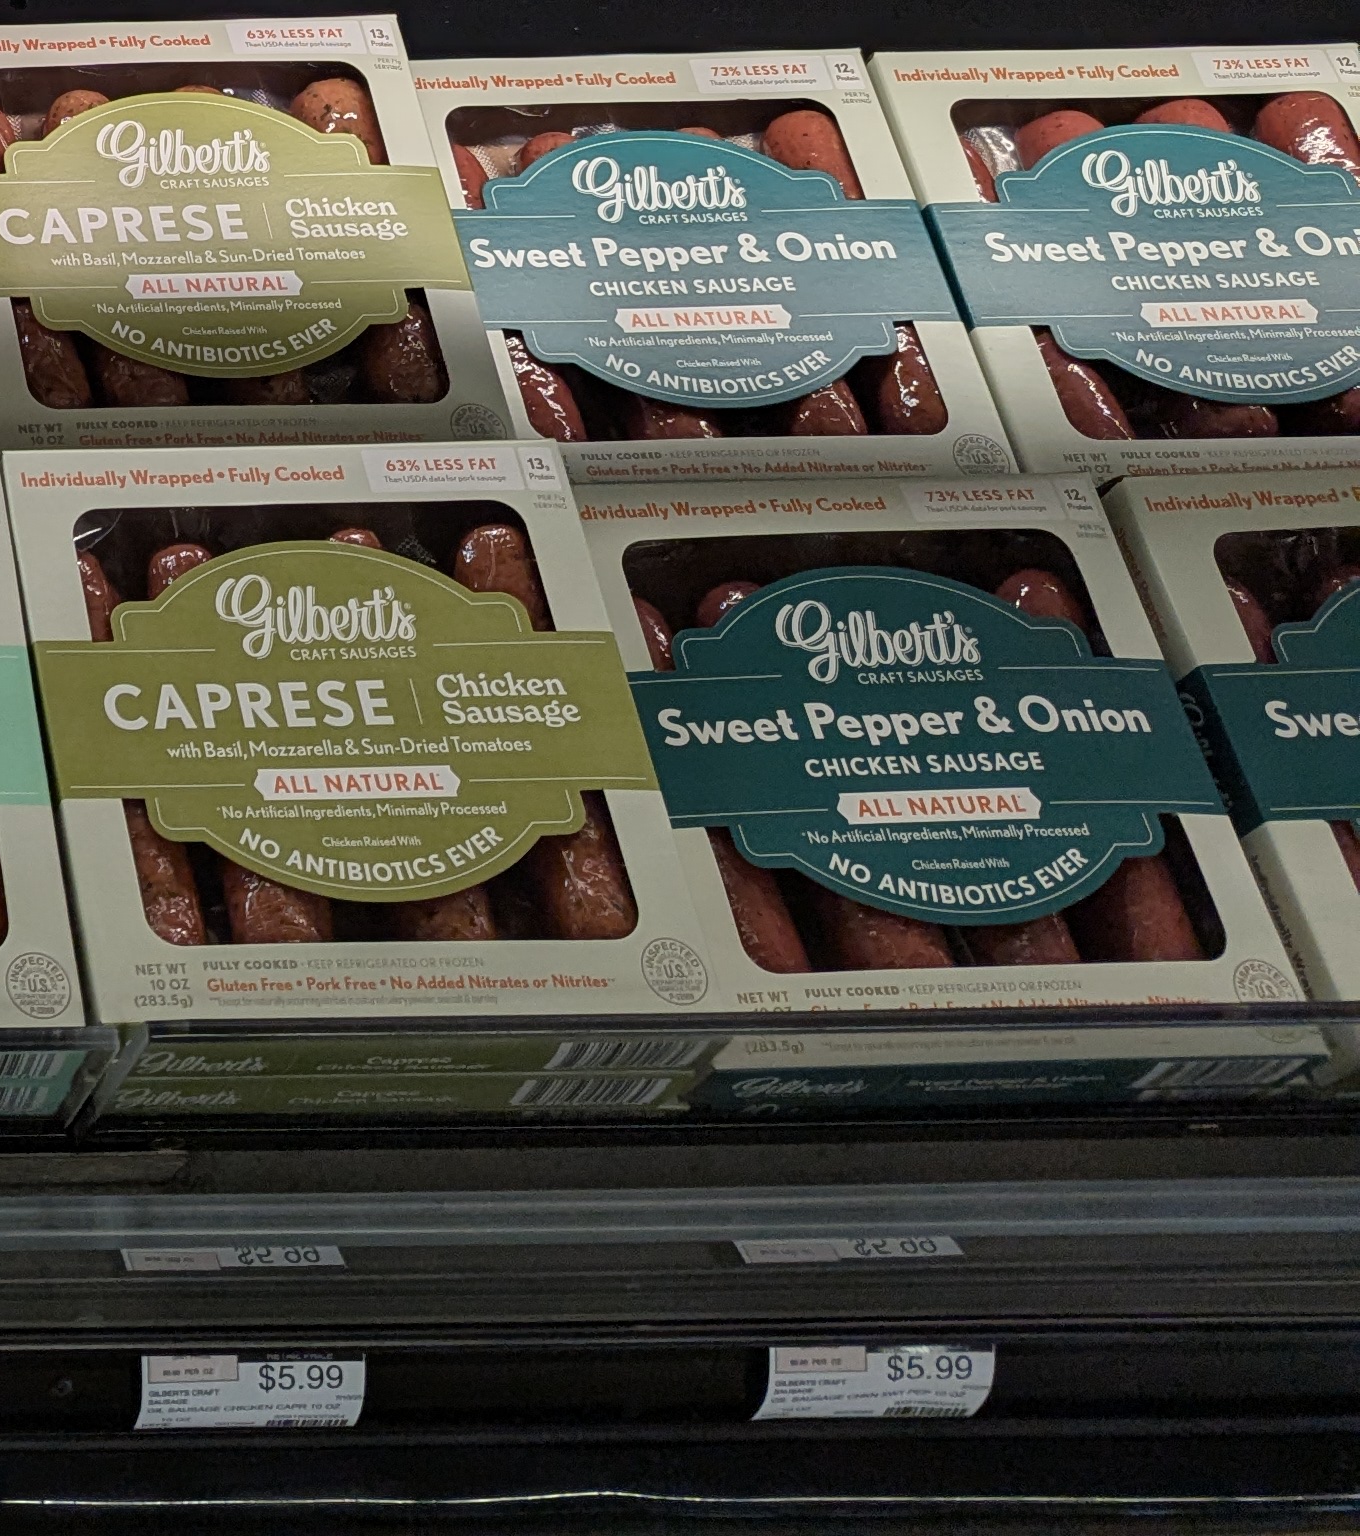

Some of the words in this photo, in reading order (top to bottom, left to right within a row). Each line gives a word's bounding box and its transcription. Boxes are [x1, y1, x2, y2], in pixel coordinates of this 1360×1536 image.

[96, 121, 270, 188] Gilbert's
[572, 157, 747, 223] Gilbert's
[1082, 150, 1262, 217] Gilbert's
[285, 197, 397, 217] Chicken
[290, 219, 409, 240] Sausage
[51, 255, 80, 267] with
[83, 252, 120, 268] Basil,
[123, 251, 202, 266] Mozzarella
[205, 251, 215, 263] &
[219, 249, 294, 263] Sun-Dried
[296, 247, 365, 262] Tomatoes
[469, 237, 584, 268] Sweet
[592, 237, 727, 272] Pepper
[738, 235, 769, 262] &
[776, 232, 897, 262] Onion
[589, 279, 688, 297] CHICKEN
[693, 276, 796, 294] SAUSAGE
[215, 574, 416, 659] Gilbert's
[289, 649, 336, 660] CRAFT
[341, 646, 416, 659] SAUSAGES
[775, 599, 980, 685] Gilbert's
[436, 673, 567, 698] Chicken
[103, 680, 395, 731] CAPRESE
[442, 700, 581, 728] Sausage
[657, 707, 798, 747] Sweet
[805, 700, 965, 747] Pepper
[976, 696, 1014, 735] &
[1018, 695, 1152, 735] Onion
[804, 755, 920, 779] CHICKEN
[926, 750, 1045, 774] SAUSAGE
[239, 826, 282, 860] NO
[287, 850, 446, 882] ANTIBIOTICS
[447, 825, 504, 871] EVER
[259, 1364, 343, 1393] $5.99
[887, 1355, 973, 1382] $5.99
